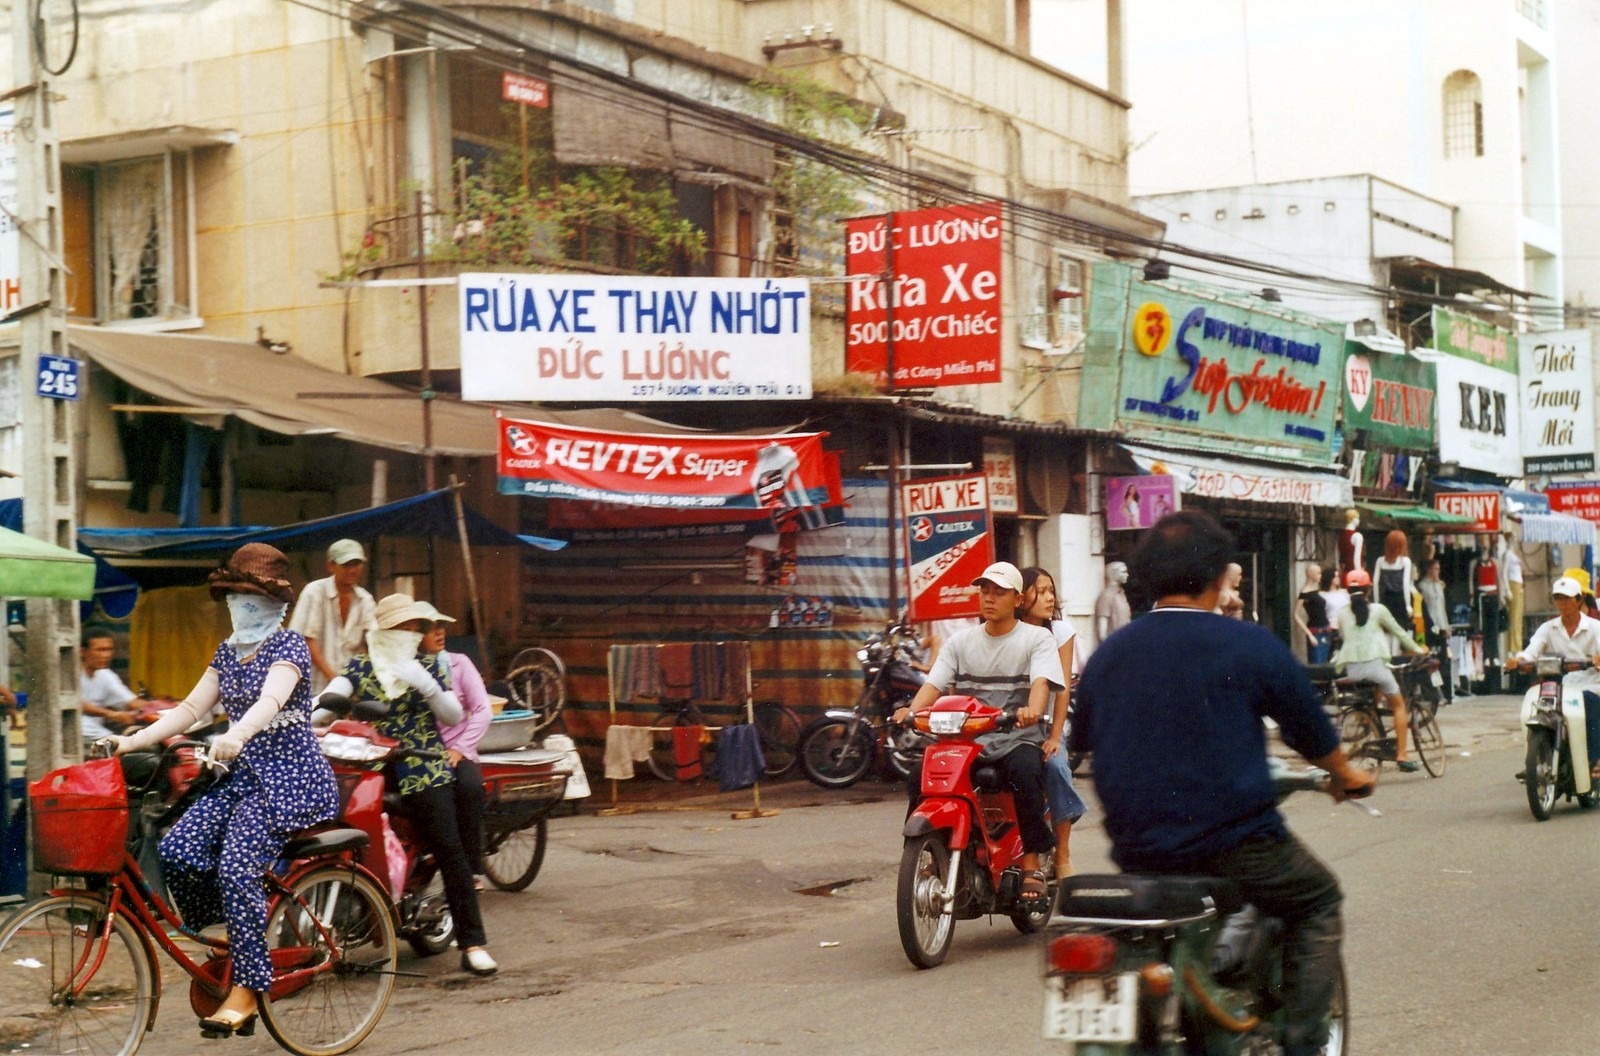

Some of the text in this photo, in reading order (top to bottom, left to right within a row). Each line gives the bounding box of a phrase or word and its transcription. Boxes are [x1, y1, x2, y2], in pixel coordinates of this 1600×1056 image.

[940, 262, 997, 304] Xe
[547, 288, 596, 333] XE
[608, 289, 697, 335] THAY
[1533, 344, 1575, 373] Thời
[39, 370, 77, 396] 245
[1350, 369, 1368, 396] KY
[1528, 380, 1581, 412] Trang
[1371, 378, 1434, 430] KENNY
[1459, 381, 1506, 437] KEN
[1537, 418, 1574, 447] Mới
[545, 437, 748, 481] REVTEX Super
[955, 481, 979, 506] XE
[1186, 465, 1225, 496] Stop
[1439, 495, 1496, 521] KENNY
[934, 540, 969, 570] 5000
